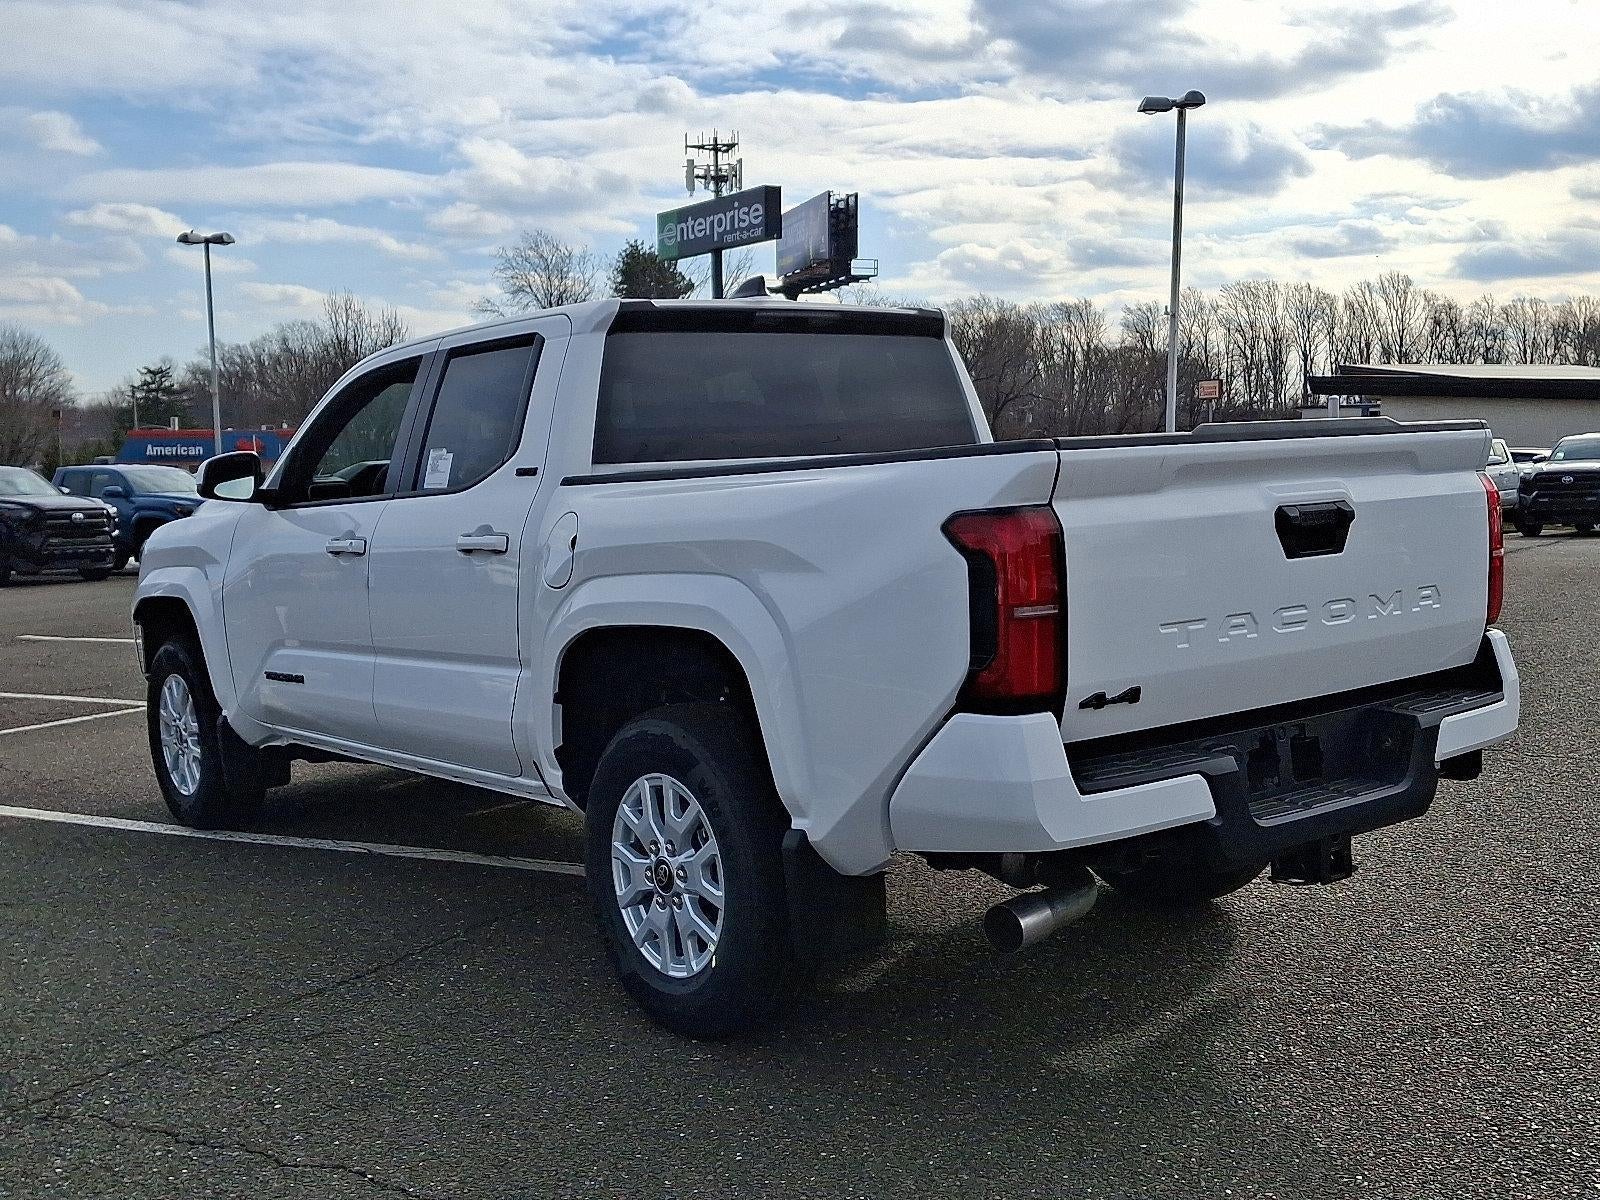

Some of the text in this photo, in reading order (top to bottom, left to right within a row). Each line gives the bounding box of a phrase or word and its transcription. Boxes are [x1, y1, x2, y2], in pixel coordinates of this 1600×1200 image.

[658, 201, 764, 245] enterprise
[723, 226, 764, 244] rent-a-car
[146, 443, 204, 456] American
[1158, 583, 1442, 649] TACOMA
